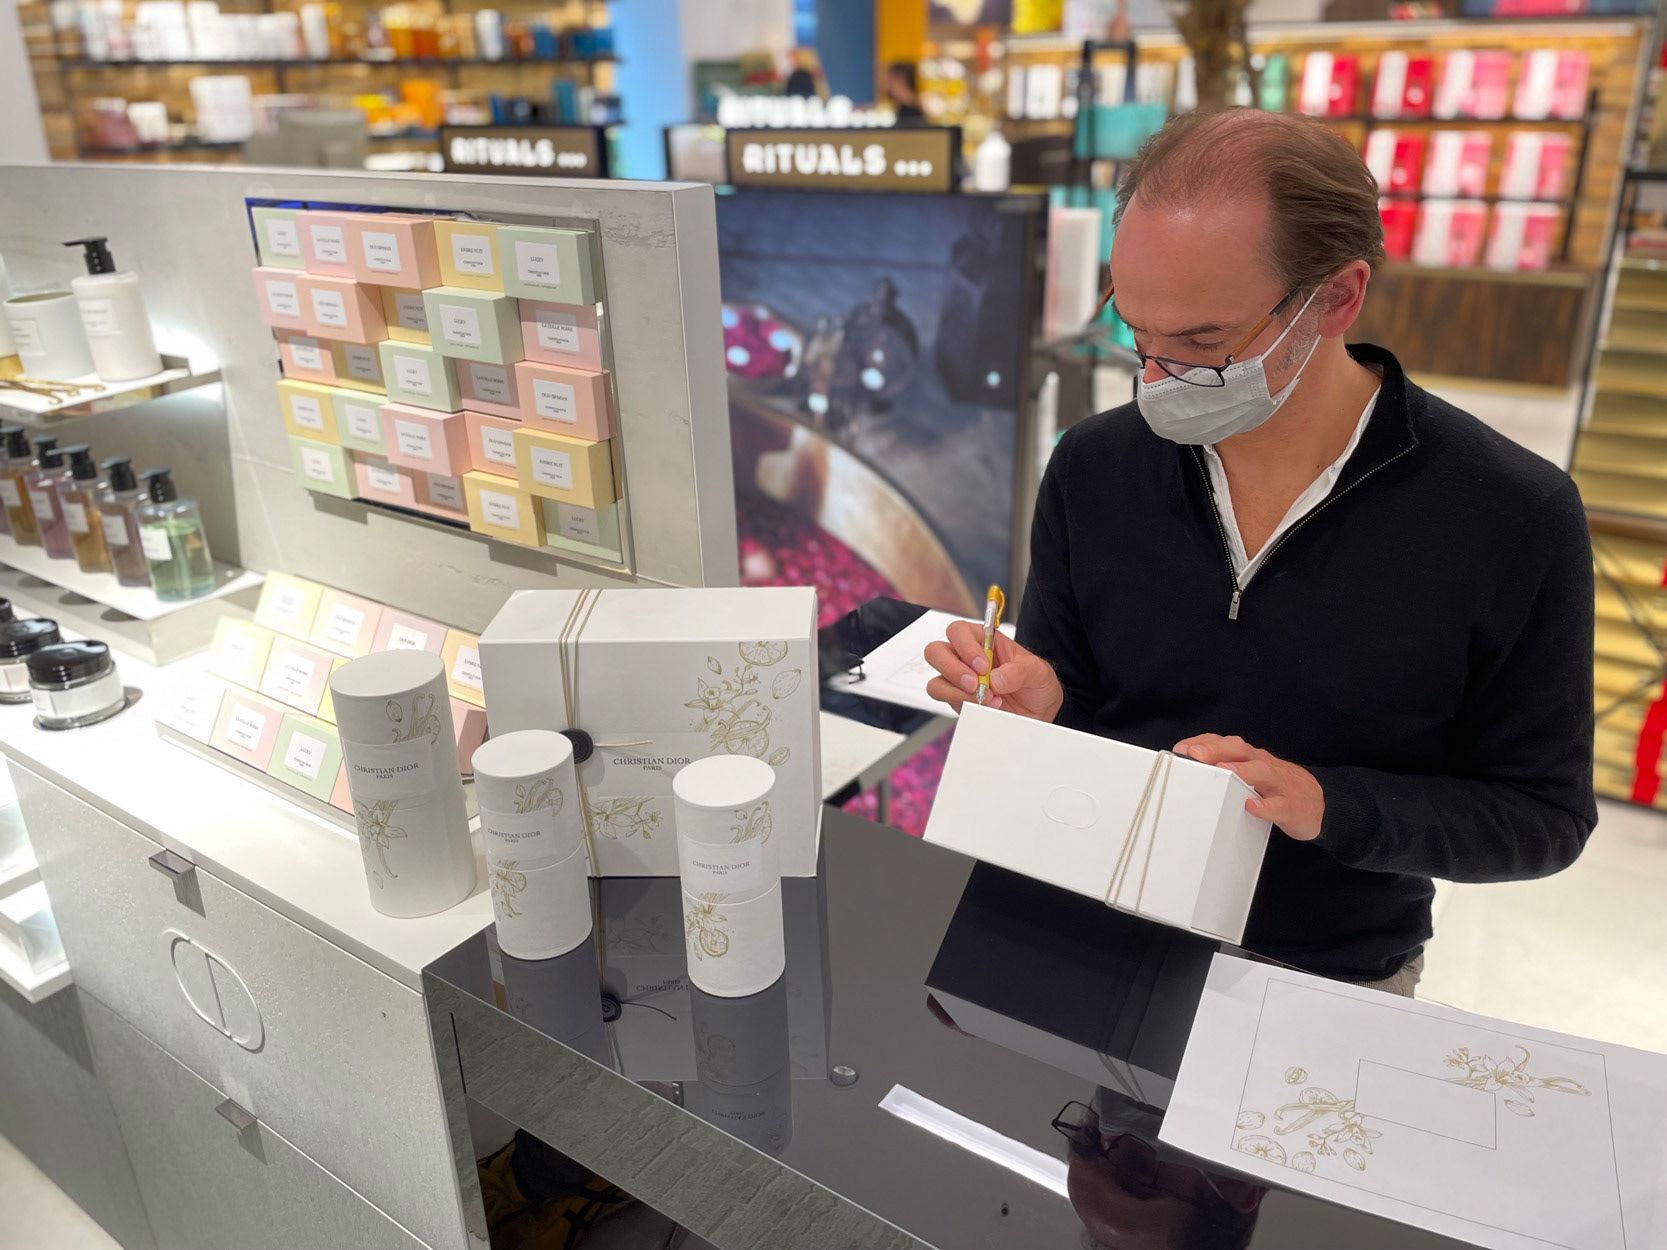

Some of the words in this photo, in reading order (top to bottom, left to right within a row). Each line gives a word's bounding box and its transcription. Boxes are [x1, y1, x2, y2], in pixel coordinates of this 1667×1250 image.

[742, 143, 887, 176] RITUALS
[354, 764, 394, 774] CHRISTIAN
[396, 762, 420, 773] DIOR
[488, 828, 520, 838] CHRISTIAN
[522, 830, 541, 838] DIOR
[692, 860, 730, 870] CHRISTIAN
[731, 861, 750, 870] DIOR
